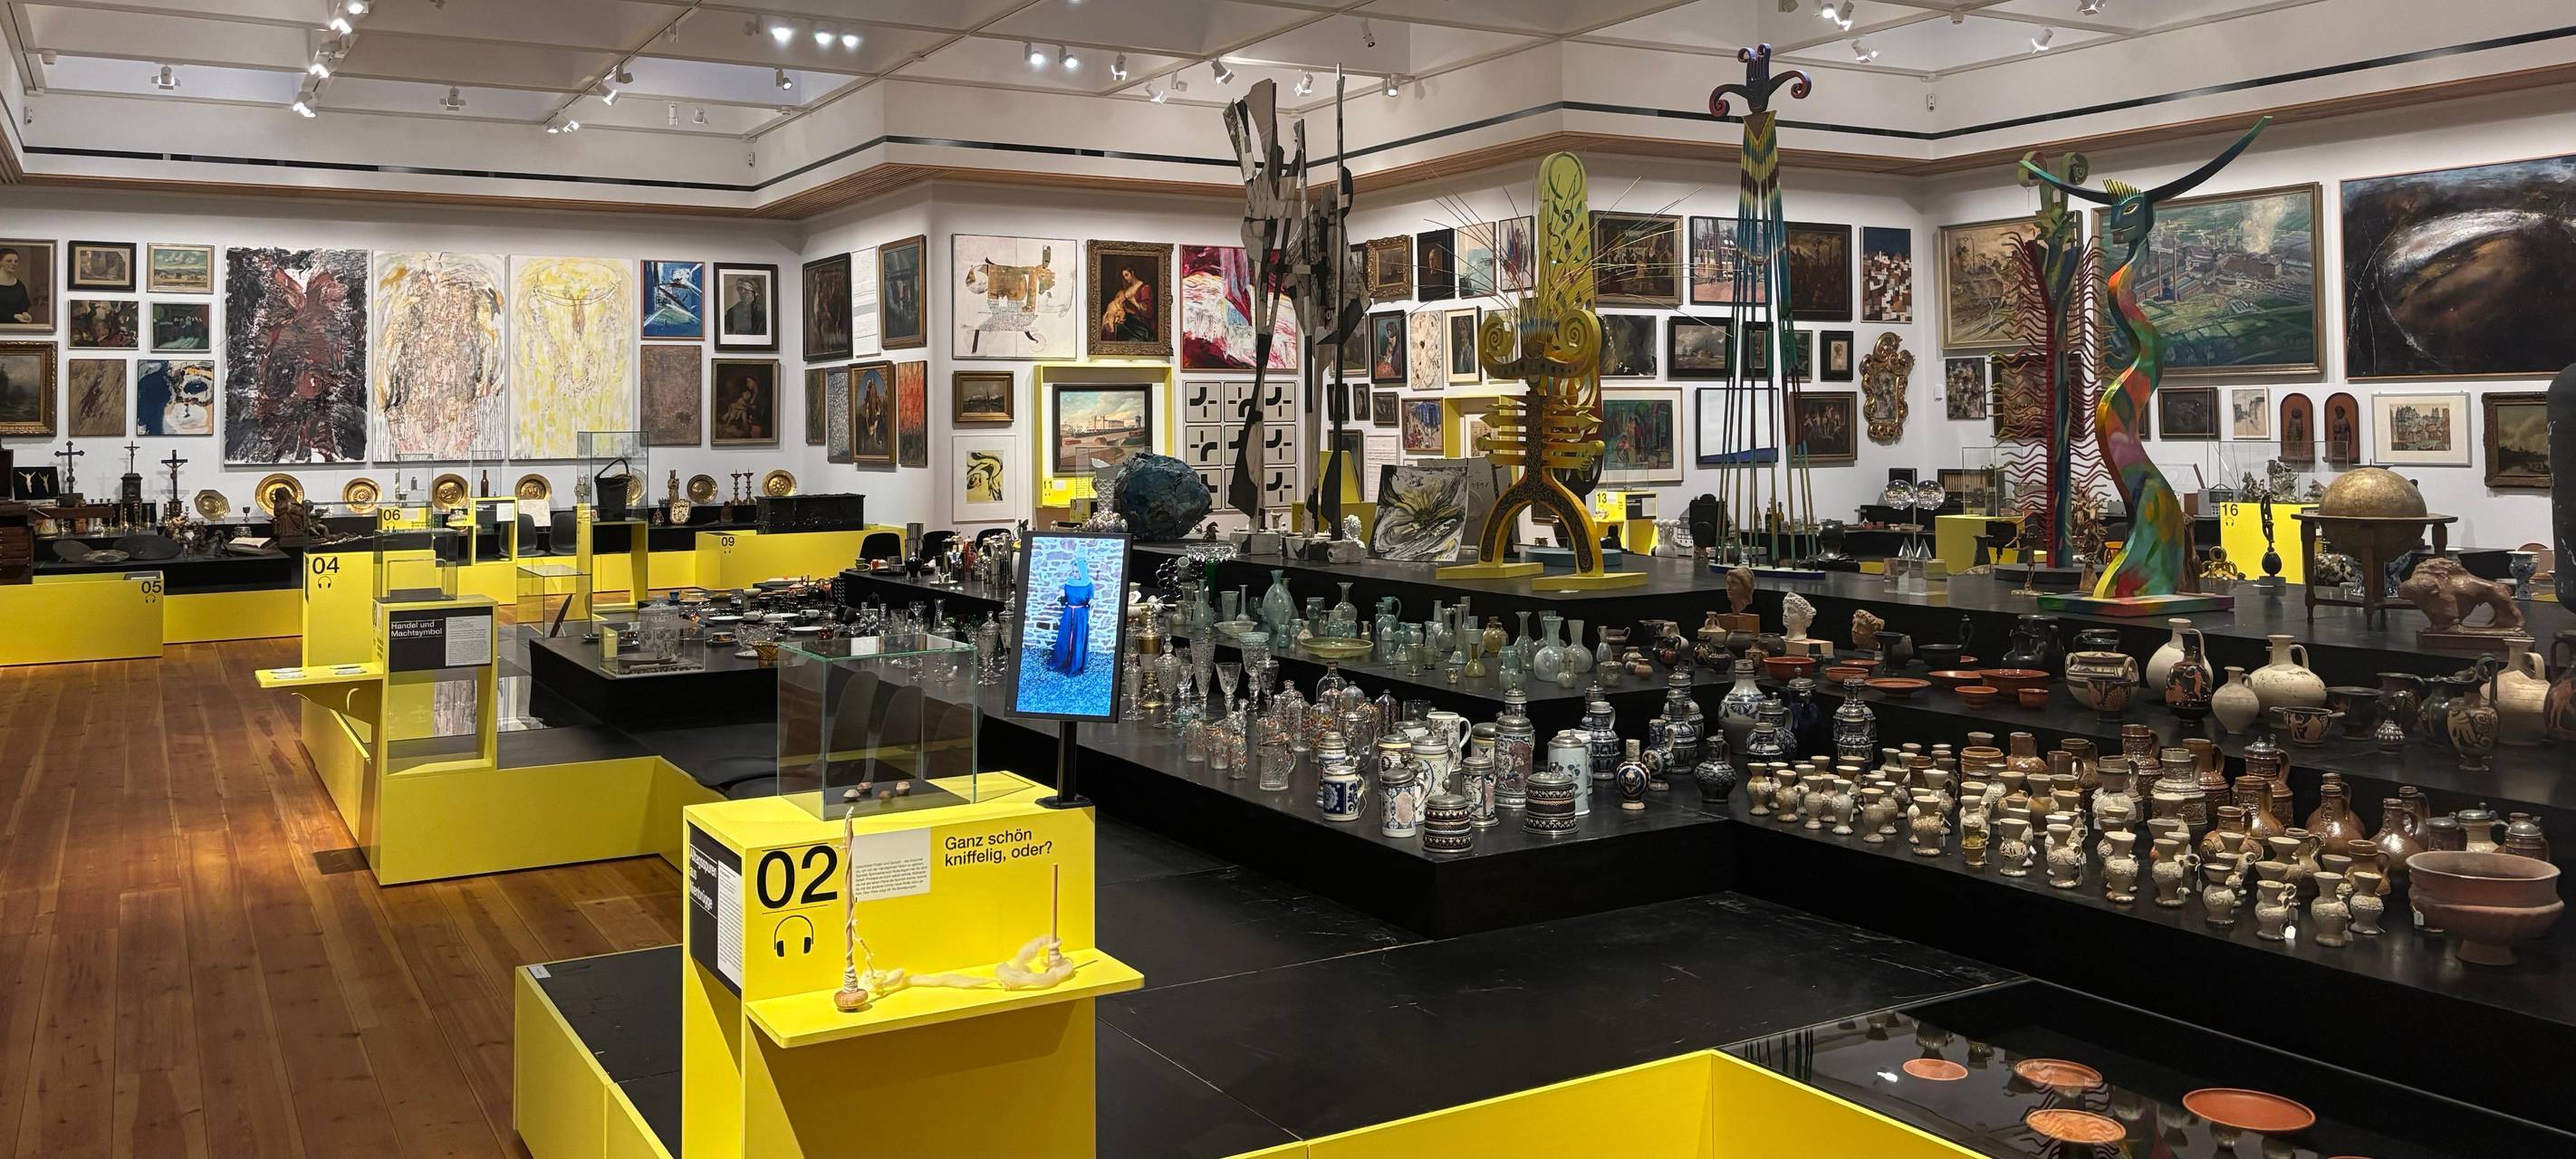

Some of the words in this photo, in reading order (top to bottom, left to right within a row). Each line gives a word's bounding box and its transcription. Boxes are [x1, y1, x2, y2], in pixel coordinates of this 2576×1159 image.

[1597, 493, 1608, 503] 13
[383, 509, 400, 521] 06
[2221, 503, 2238, 516] 16
[721, 537, 735, 547] 09
[312, 557, 340, 574] 04
[141, 580, 162, 594] 05
[391, 621, 418, 629] Handel
[390, 627, 443, 637] Machtsymbol
[945, 836, 984, 850] Ganz
[988, 829, 1033, 845] schön
[945, 848, 1006, 867] kniffelig,
[1012, 840, 1053, 858] oder?
[690, 847, 717, 878] Alltagsspuren
[689, 867, 697, 880] aus
[756, 845, 838, 909] 02
